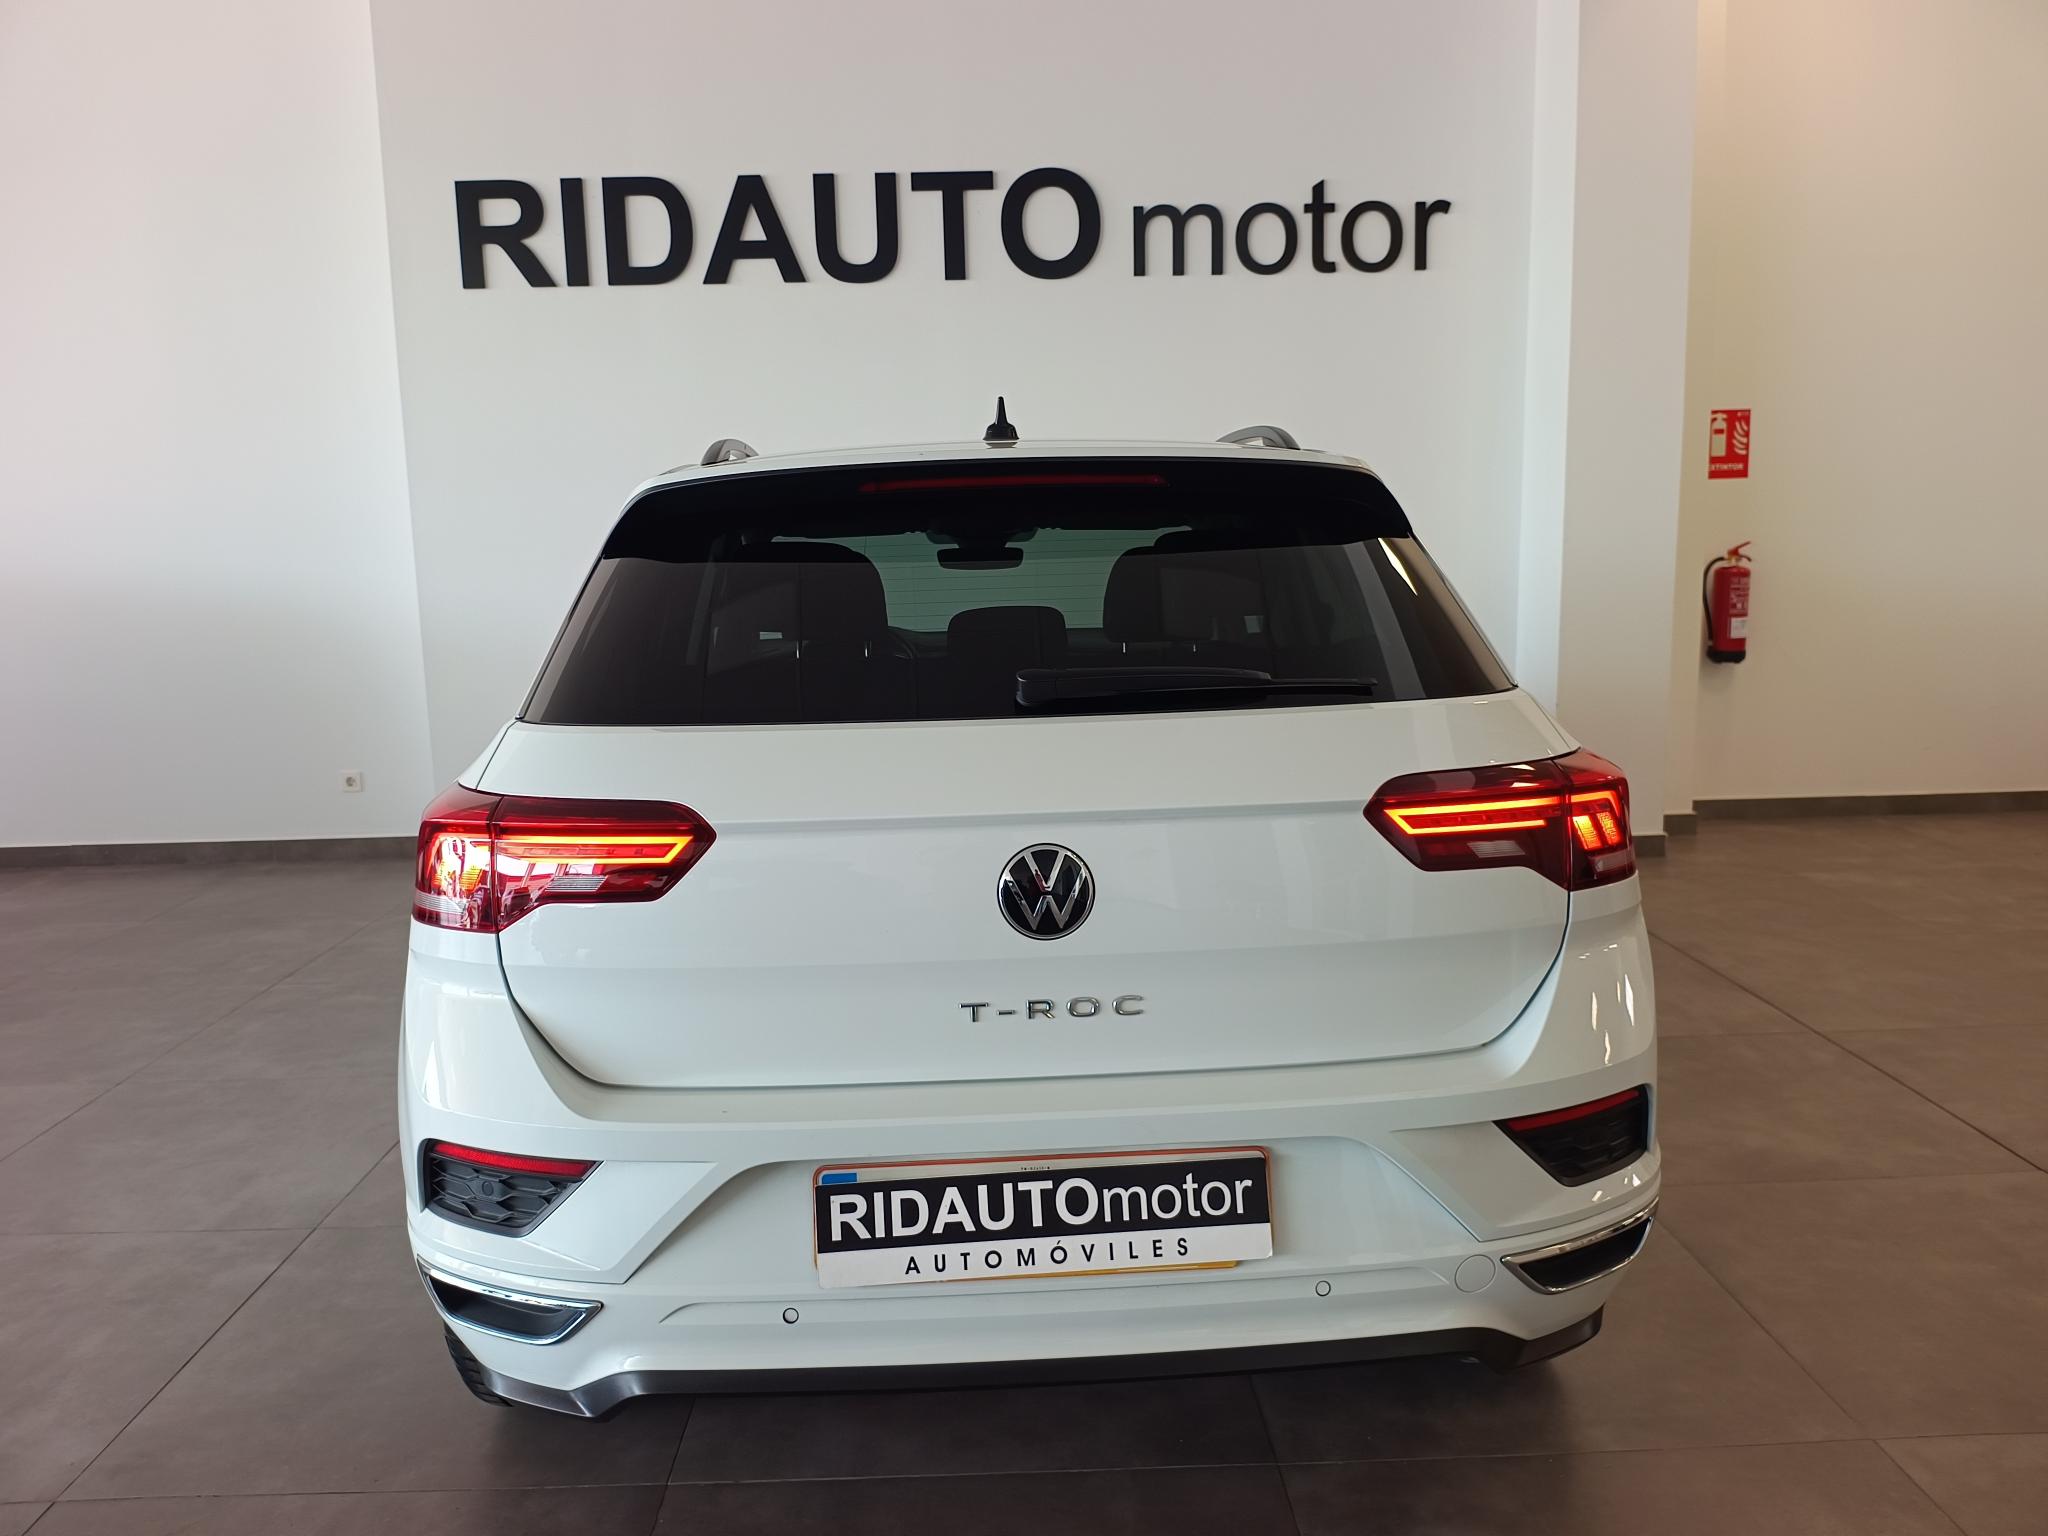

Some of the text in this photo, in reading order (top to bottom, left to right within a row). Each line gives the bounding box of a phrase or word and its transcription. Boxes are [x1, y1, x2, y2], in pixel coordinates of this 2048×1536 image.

[455, 168, 1452, 290] RIDAUTO motor
[959, 995, 1145, 1023] T-ROC
[904, 1239, 1189, 1276] AUTOMÓVILES
